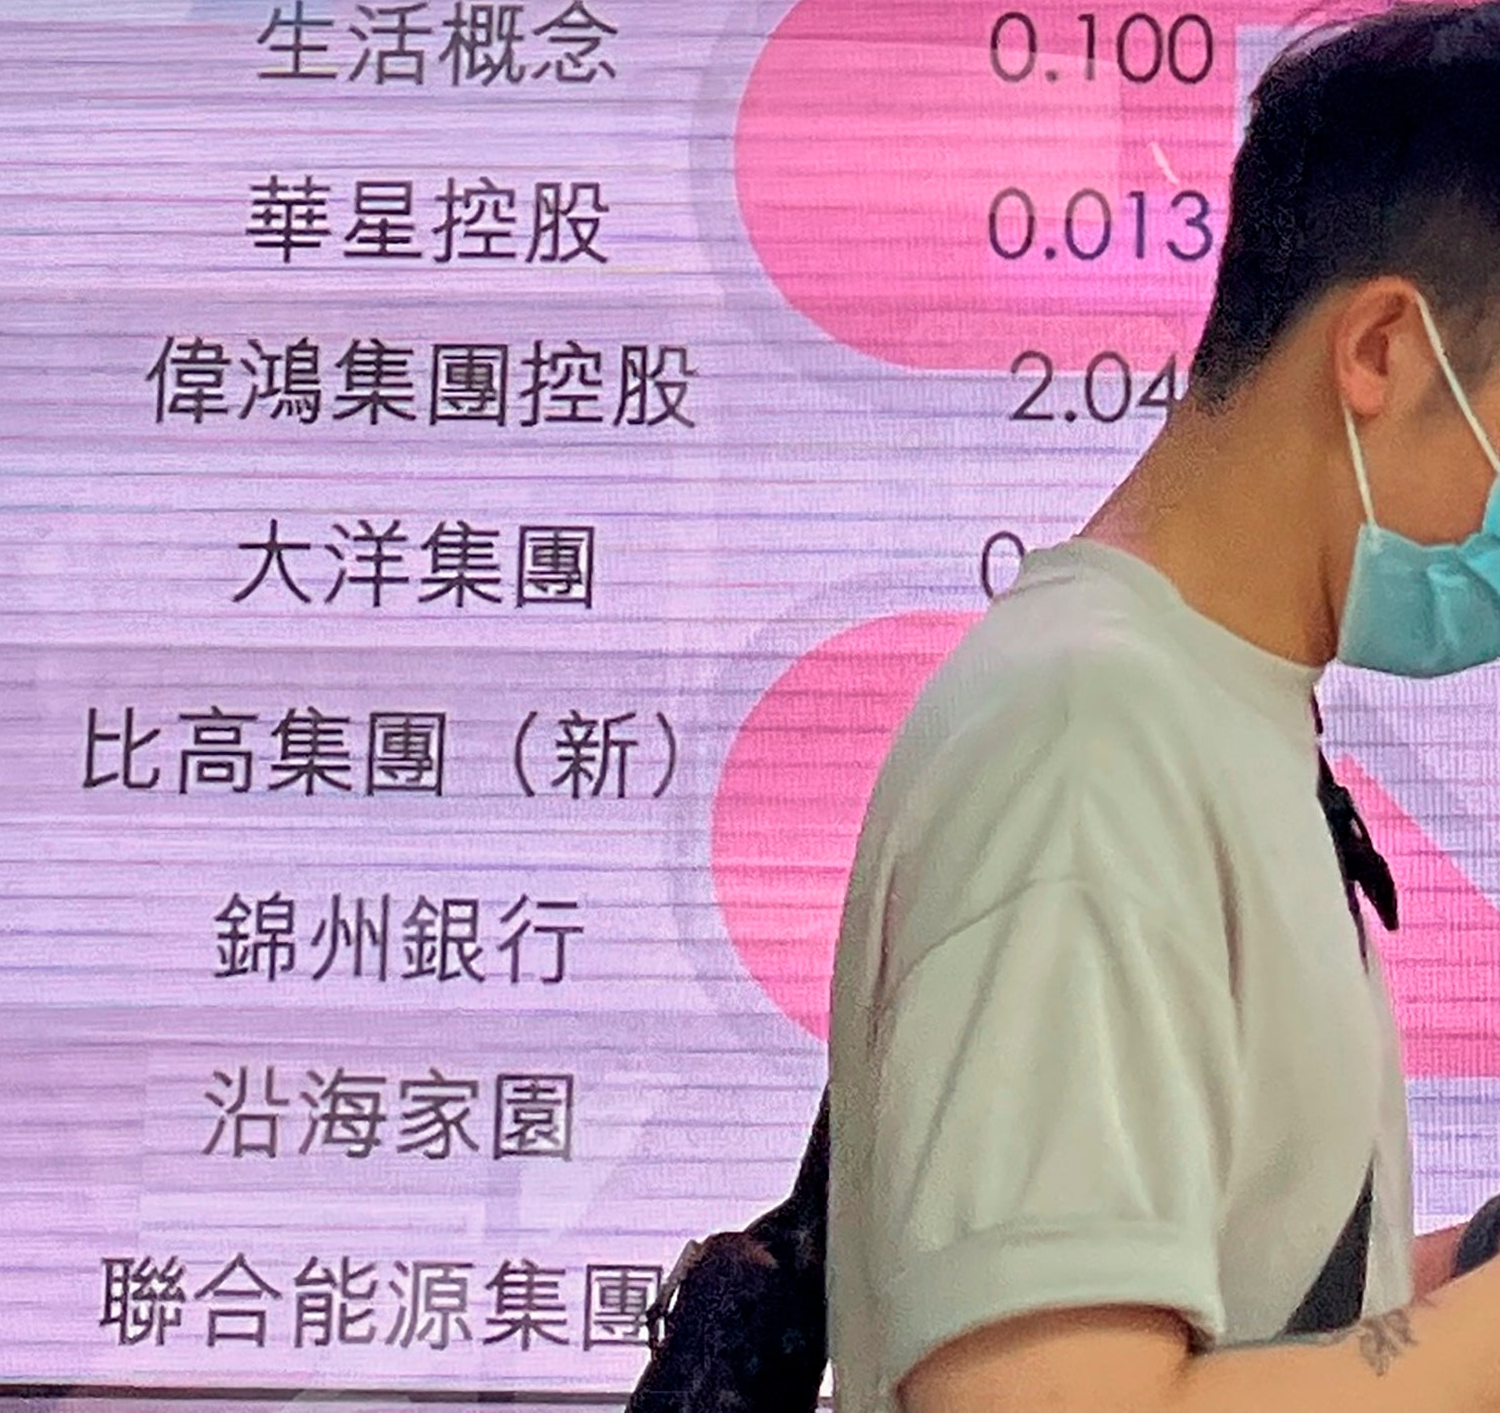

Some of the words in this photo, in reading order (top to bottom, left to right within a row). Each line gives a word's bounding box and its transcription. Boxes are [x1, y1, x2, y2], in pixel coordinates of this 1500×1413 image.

[257, 0, 618, 87] 生活概念
[990, 11, 1214, 85] 0.100
[245, 175, 609, 264] 華星控股
[988, 189, 1214, 260] 0.013
[146, 336, 695, 428] 偉鴻集團控股
[1007, 349, 1178, 425] 2.04
[233, 518, 595, 610] 大洋集團
[213, 891, 584, 984] 錦州銀行
[202, 1067, 574, 1161] 沿海家園
[99, 1254, 670, 1357] 聯合能源集團
